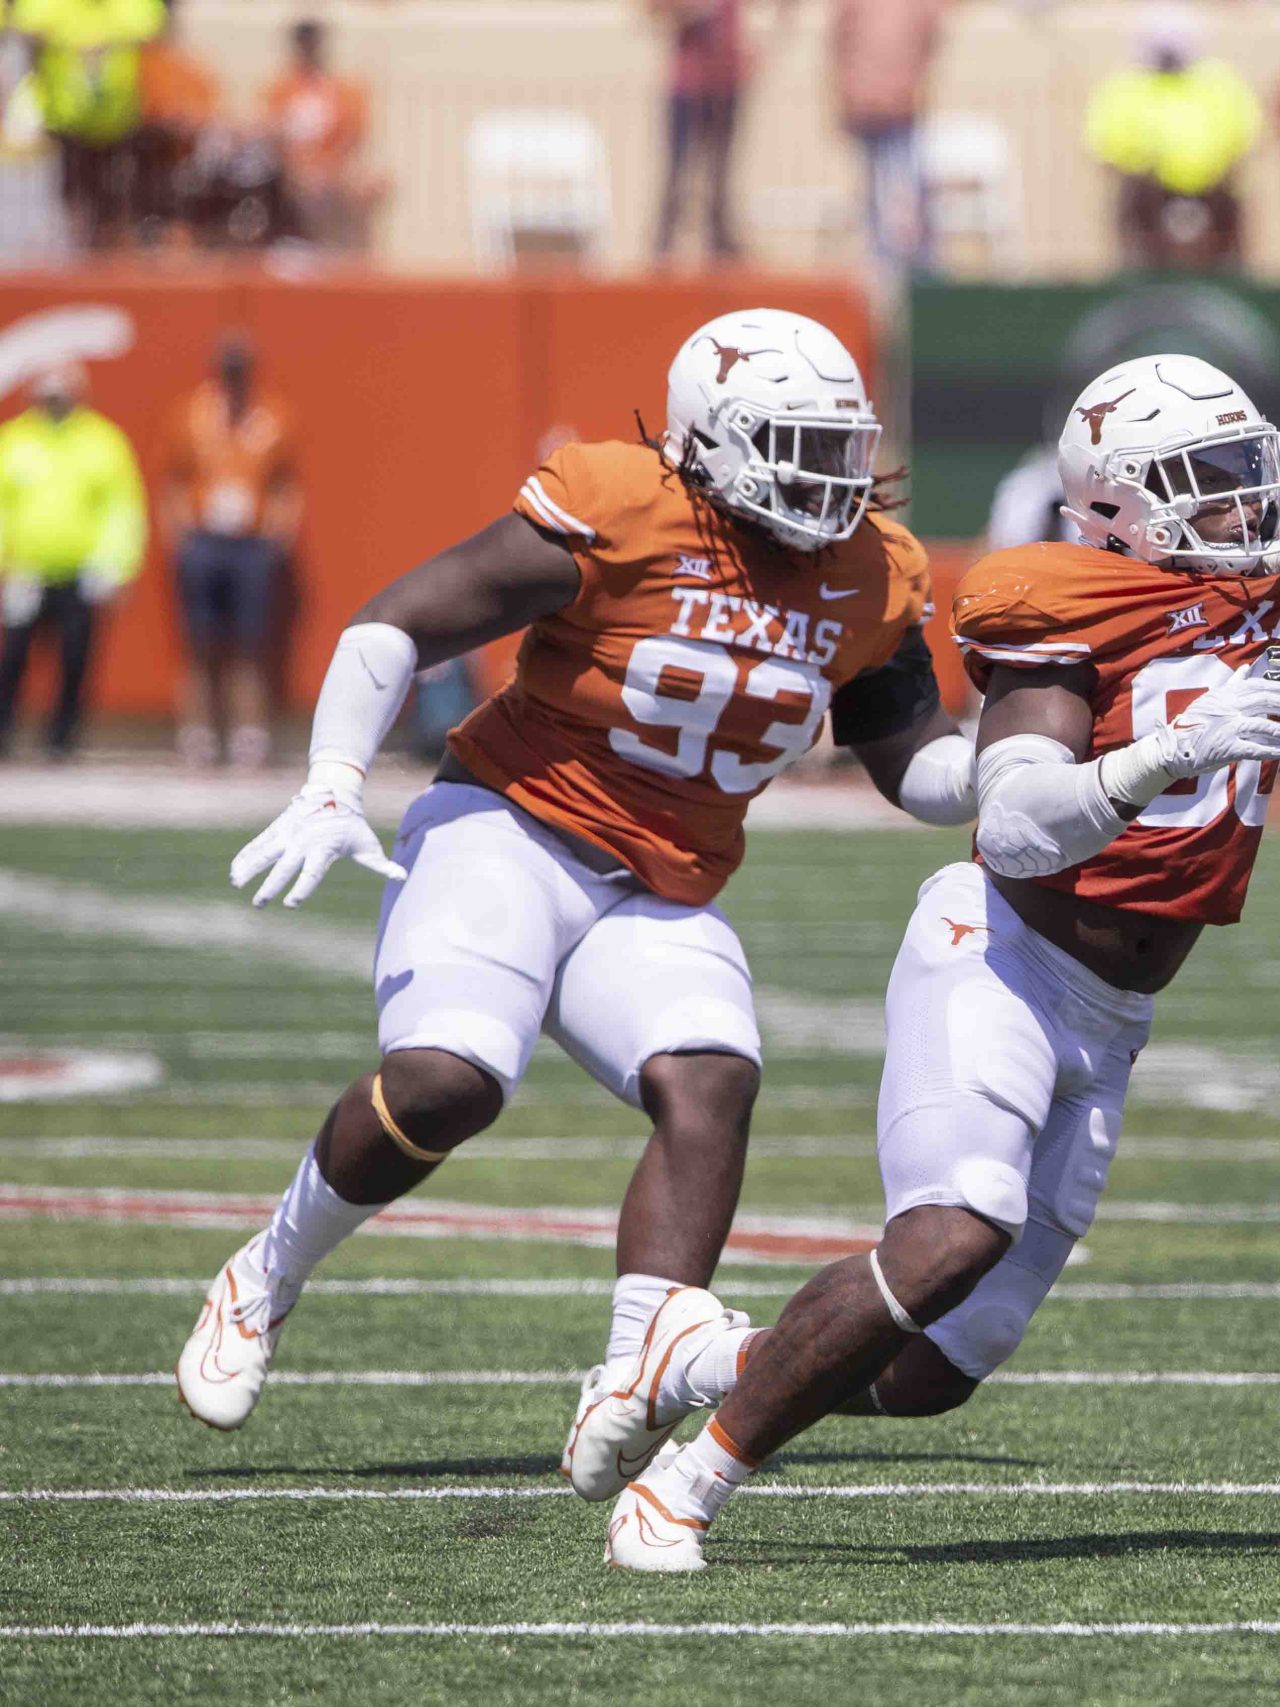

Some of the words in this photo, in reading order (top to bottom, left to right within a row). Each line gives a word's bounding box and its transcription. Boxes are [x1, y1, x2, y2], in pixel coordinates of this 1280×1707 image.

[1215, 410, 1248, 426] HORNS
[669, 586, 843, 667] TEXAS
[608, 634, 832, 794] 93
